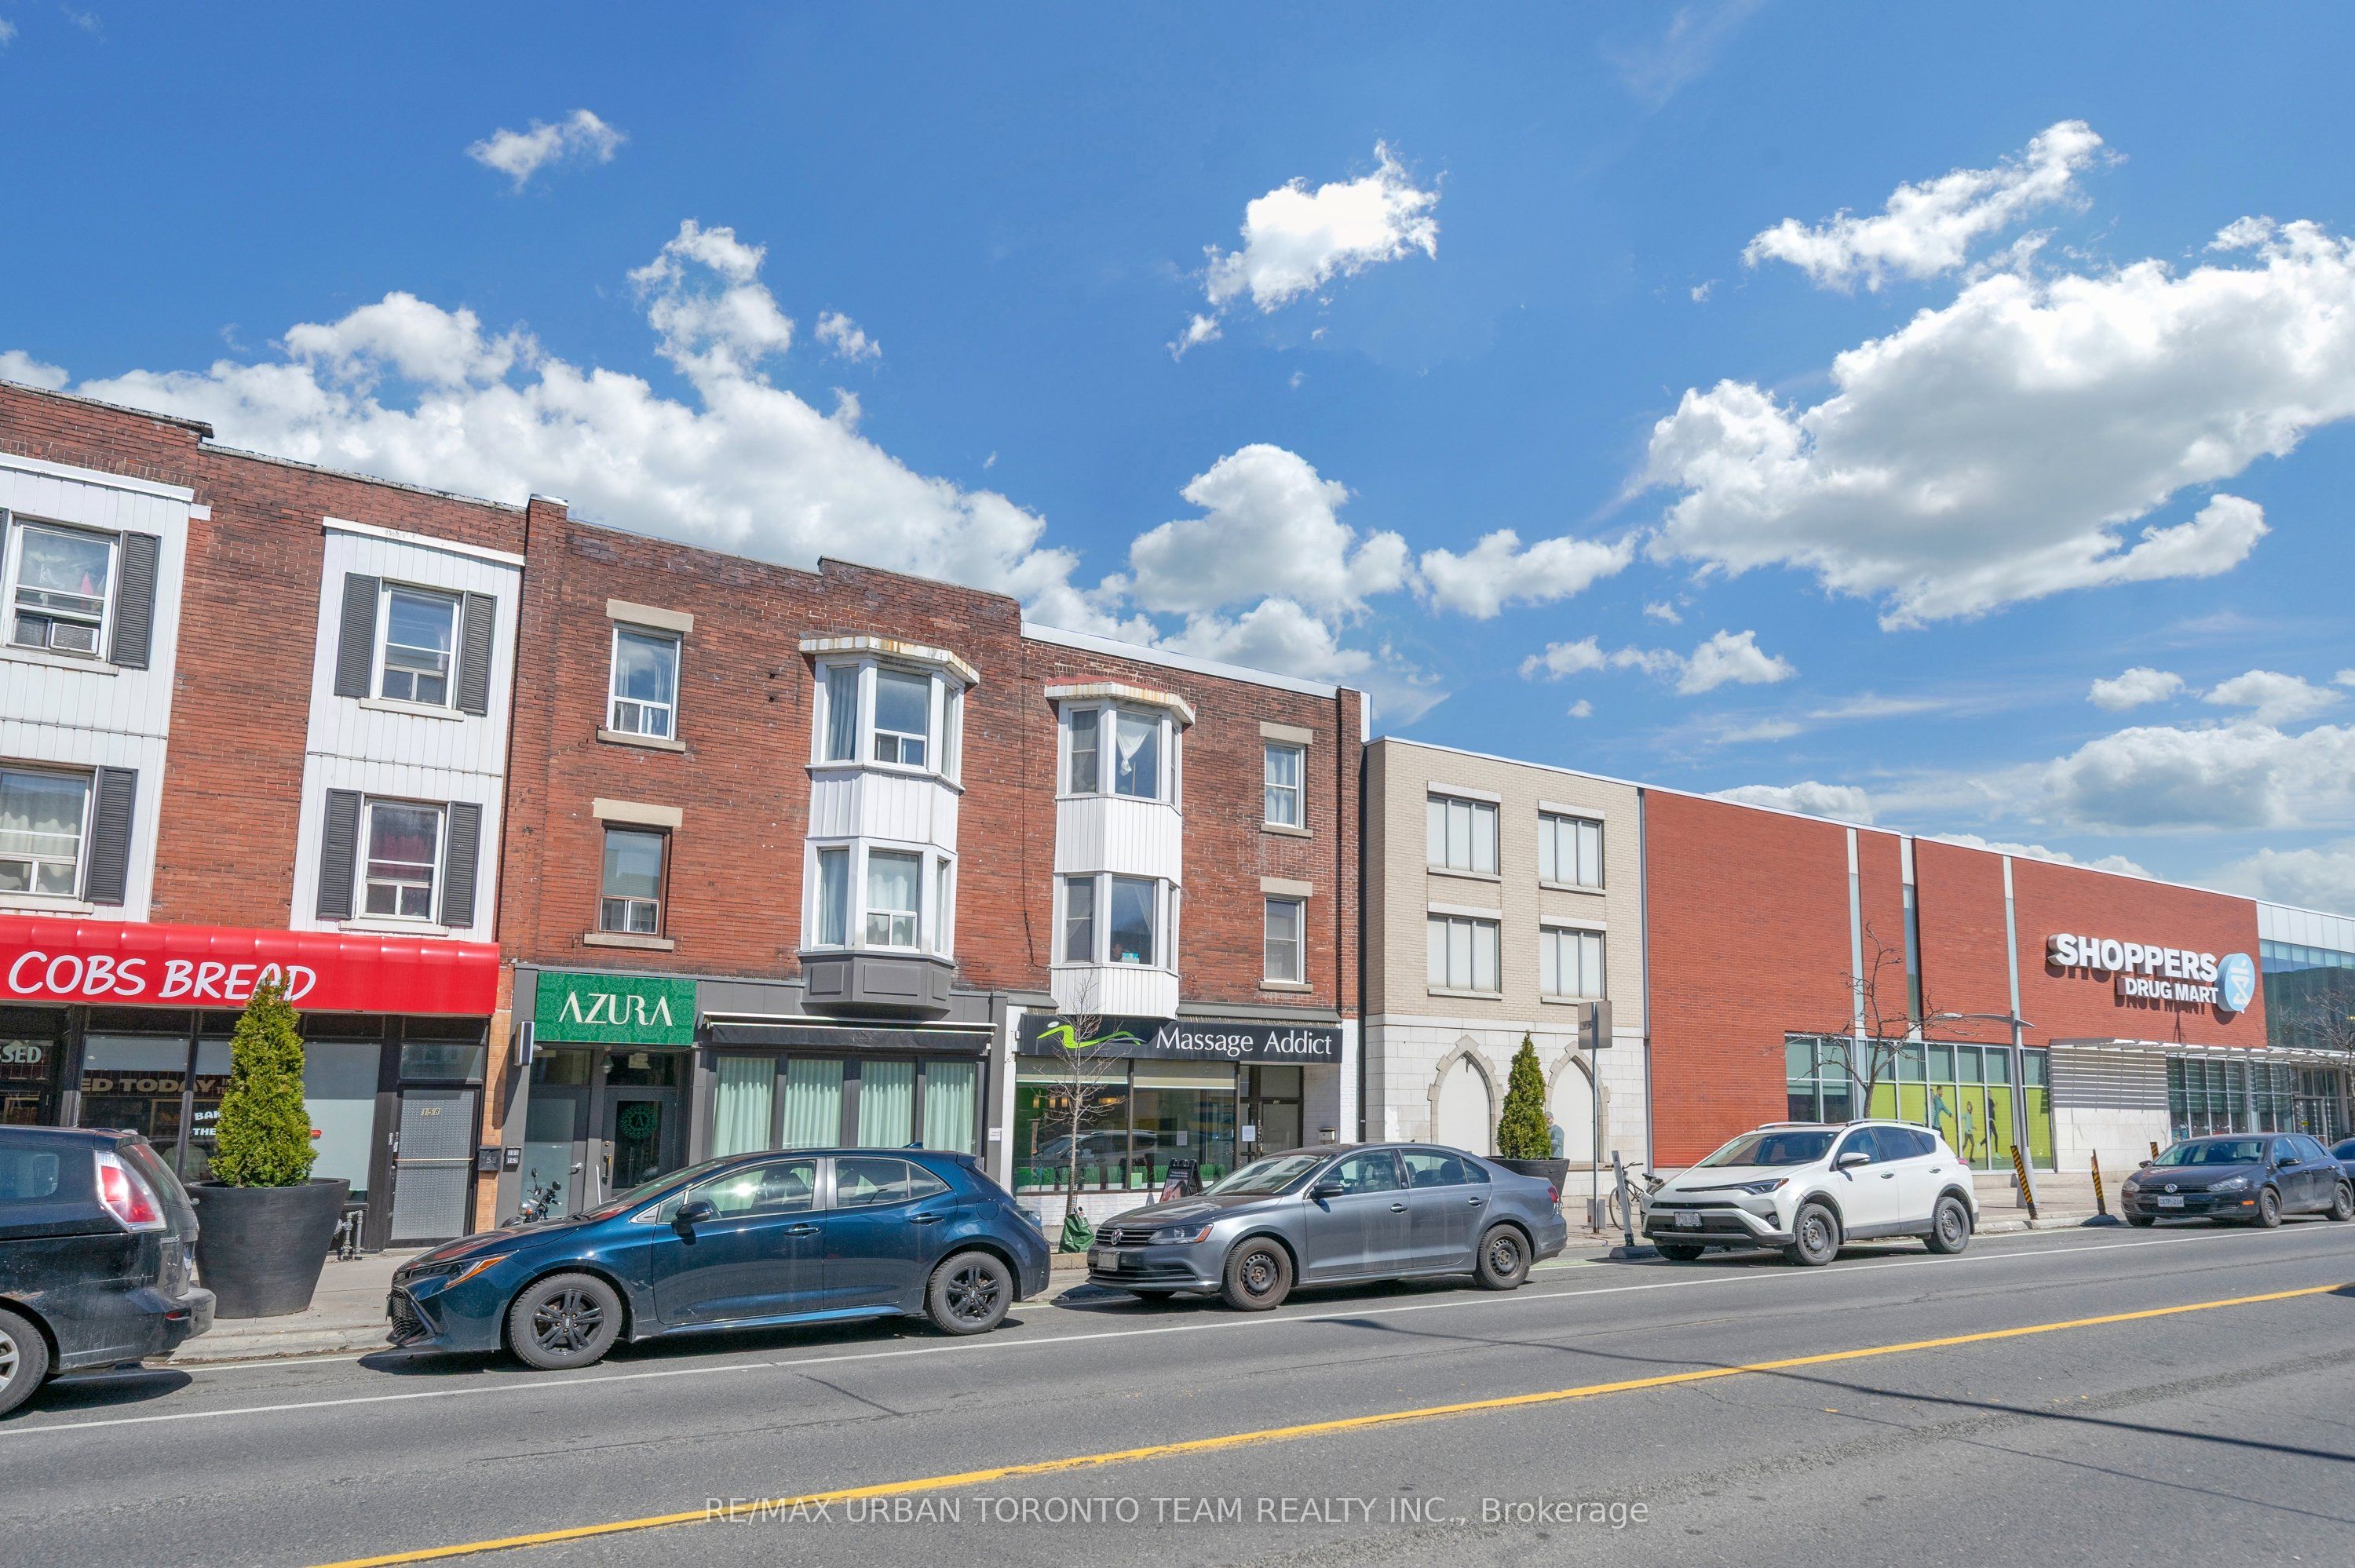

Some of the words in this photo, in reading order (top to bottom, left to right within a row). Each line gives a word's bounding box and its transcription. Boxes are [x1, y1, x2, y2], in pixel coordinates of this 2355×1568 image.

[2048, 933, 2218, 982] SHOPPERS
[8, 951, 146, 996] COBS
[158, 959, 316, 1001] BREAD
[2123, 977, 2173, 1000] DRUG
[2174, 983, 2218, 1004] MART
[558, 991, 673, 1026] AZURA
[0, 1046, 42, 1063] SED
[1156, 1026, 1254, 1057] Massage
[1263, 1030, 1332, 1055] Addict
